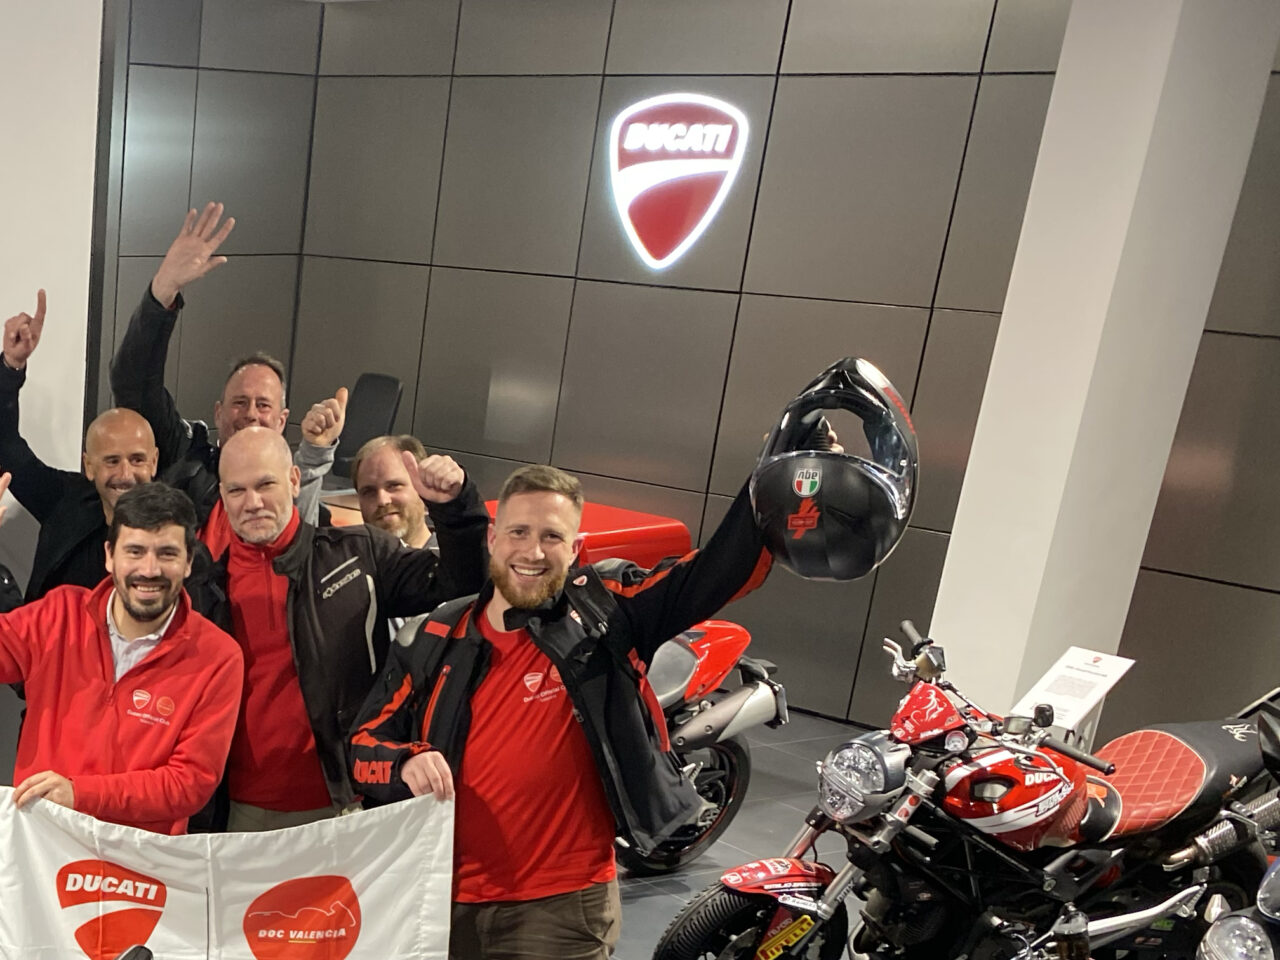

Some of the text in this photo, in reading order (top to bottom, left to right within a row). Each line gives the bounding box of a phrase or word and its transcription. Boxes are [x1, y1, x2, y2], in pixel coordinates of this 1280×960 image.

[623, 123, 733, 152] DUCATI
[65, 873, 158, 900] DUCATI
[258, 928, 346, 939] DOC VALENCIA
